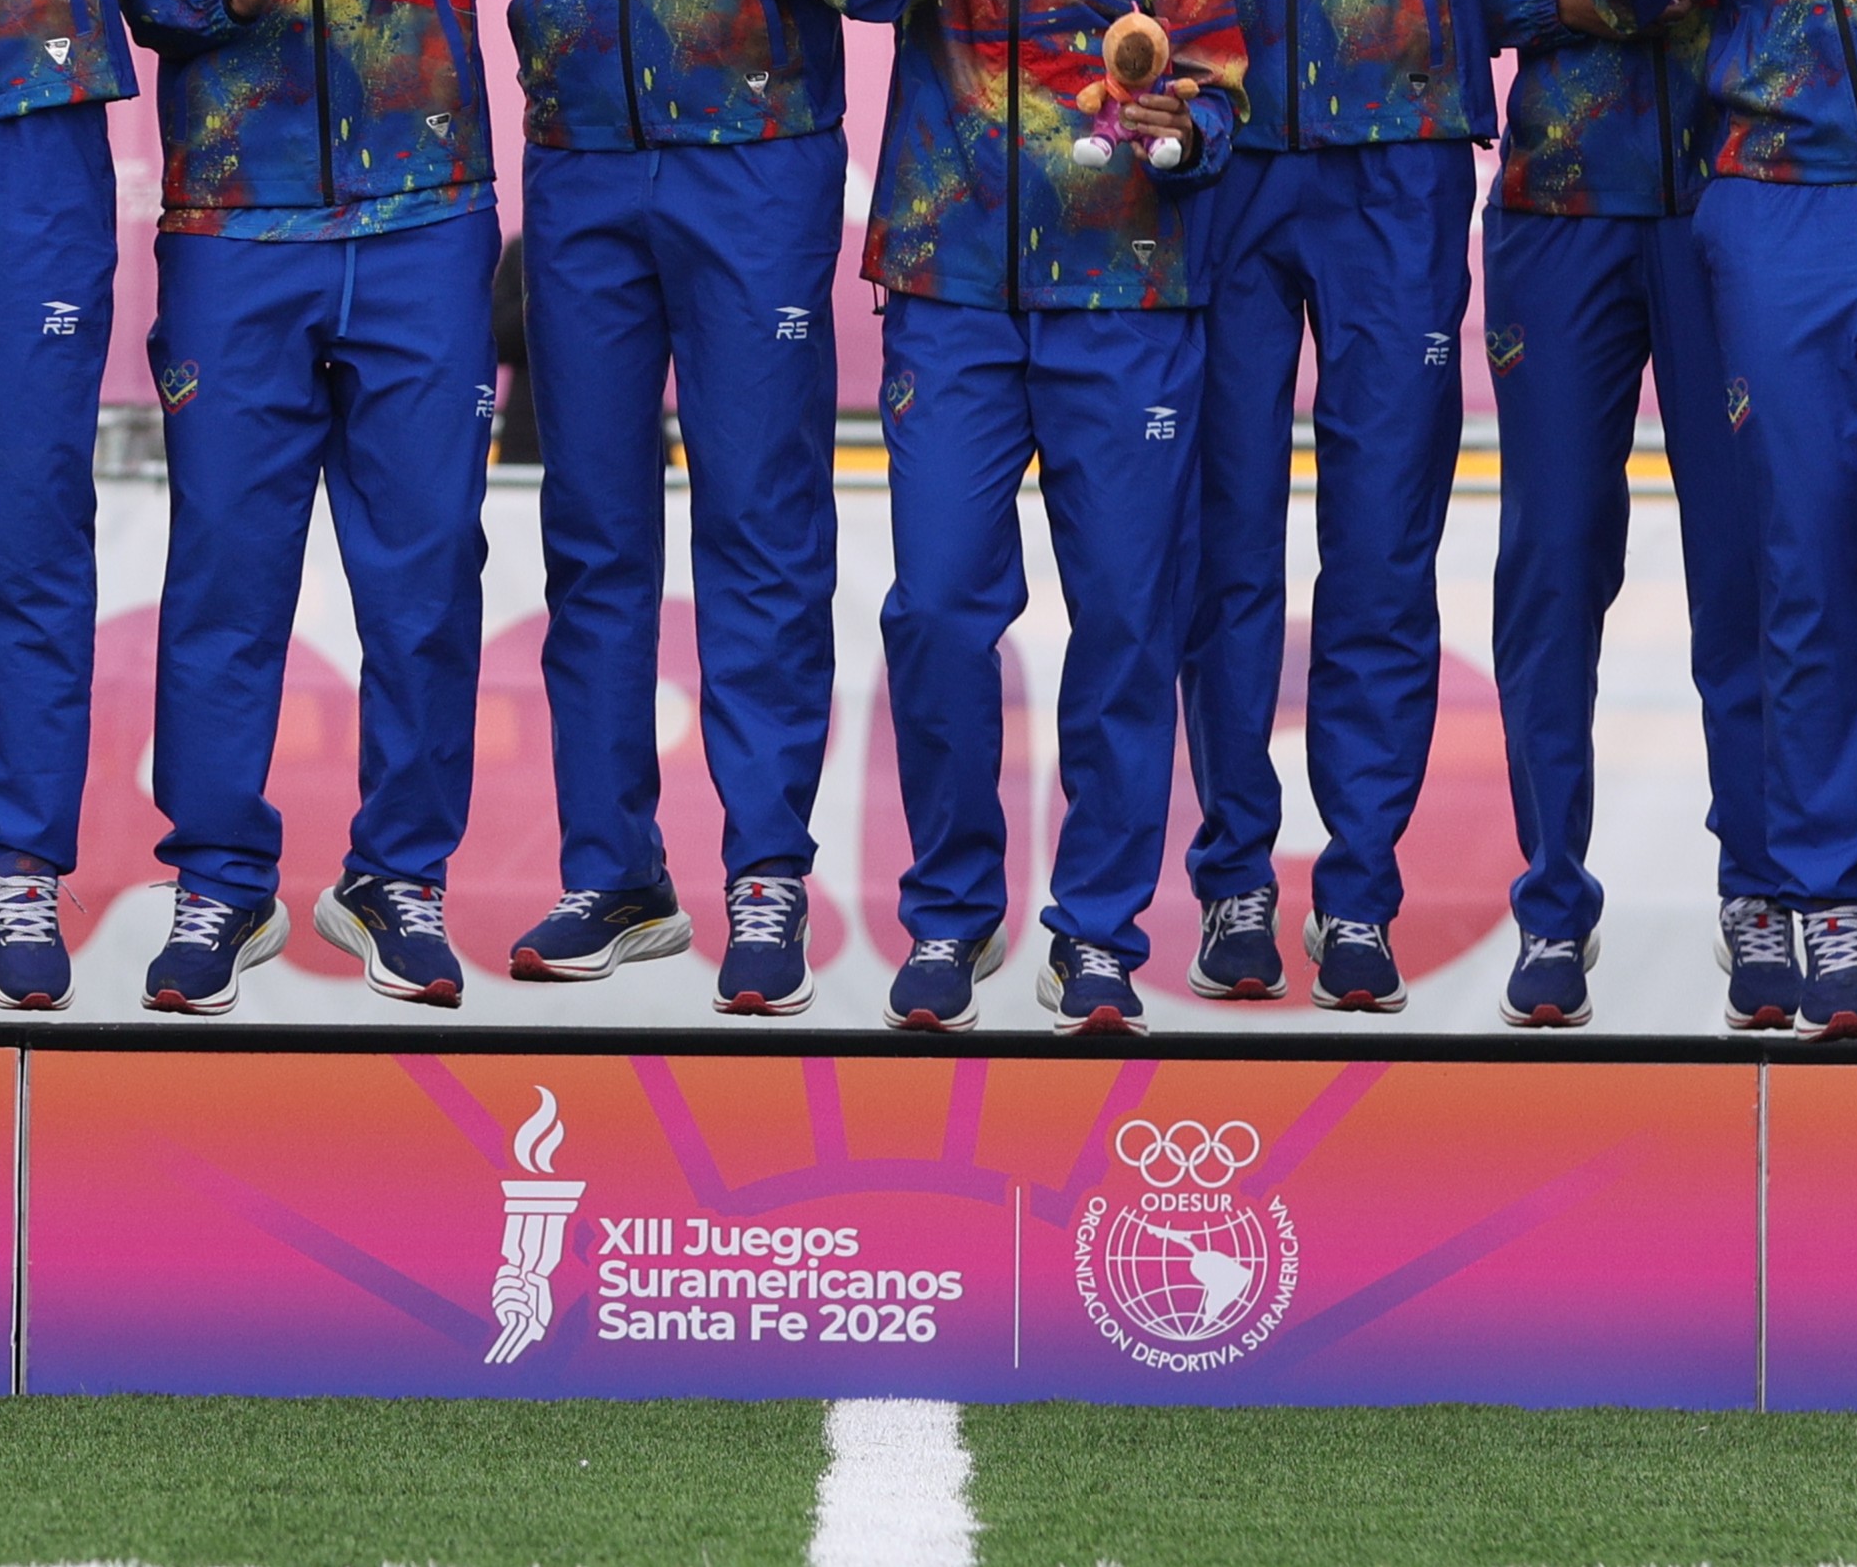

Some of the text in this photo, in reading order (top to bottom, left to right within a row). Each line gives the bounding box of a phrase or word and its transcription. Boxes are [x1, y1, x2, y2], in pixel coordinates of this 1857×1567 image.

[43, 317, 78, 334] RS
[776, 322, 808, 339] RS
[1424, 348, 1449, 365] RS
[1146, 421, 1175, 439] RS
[1141, 1193, 1233, 1212] ODESUR
[598, 1218, 859, 1266] XIII Juegos
[598, 1258, 963, 1300] Suramericanos
[1074, 1194, 1300, 1373] ORGANIZACION DEPORTIVA SURAMERICANA
[598, 1302, 937, 1343] Santa Fe 2026
